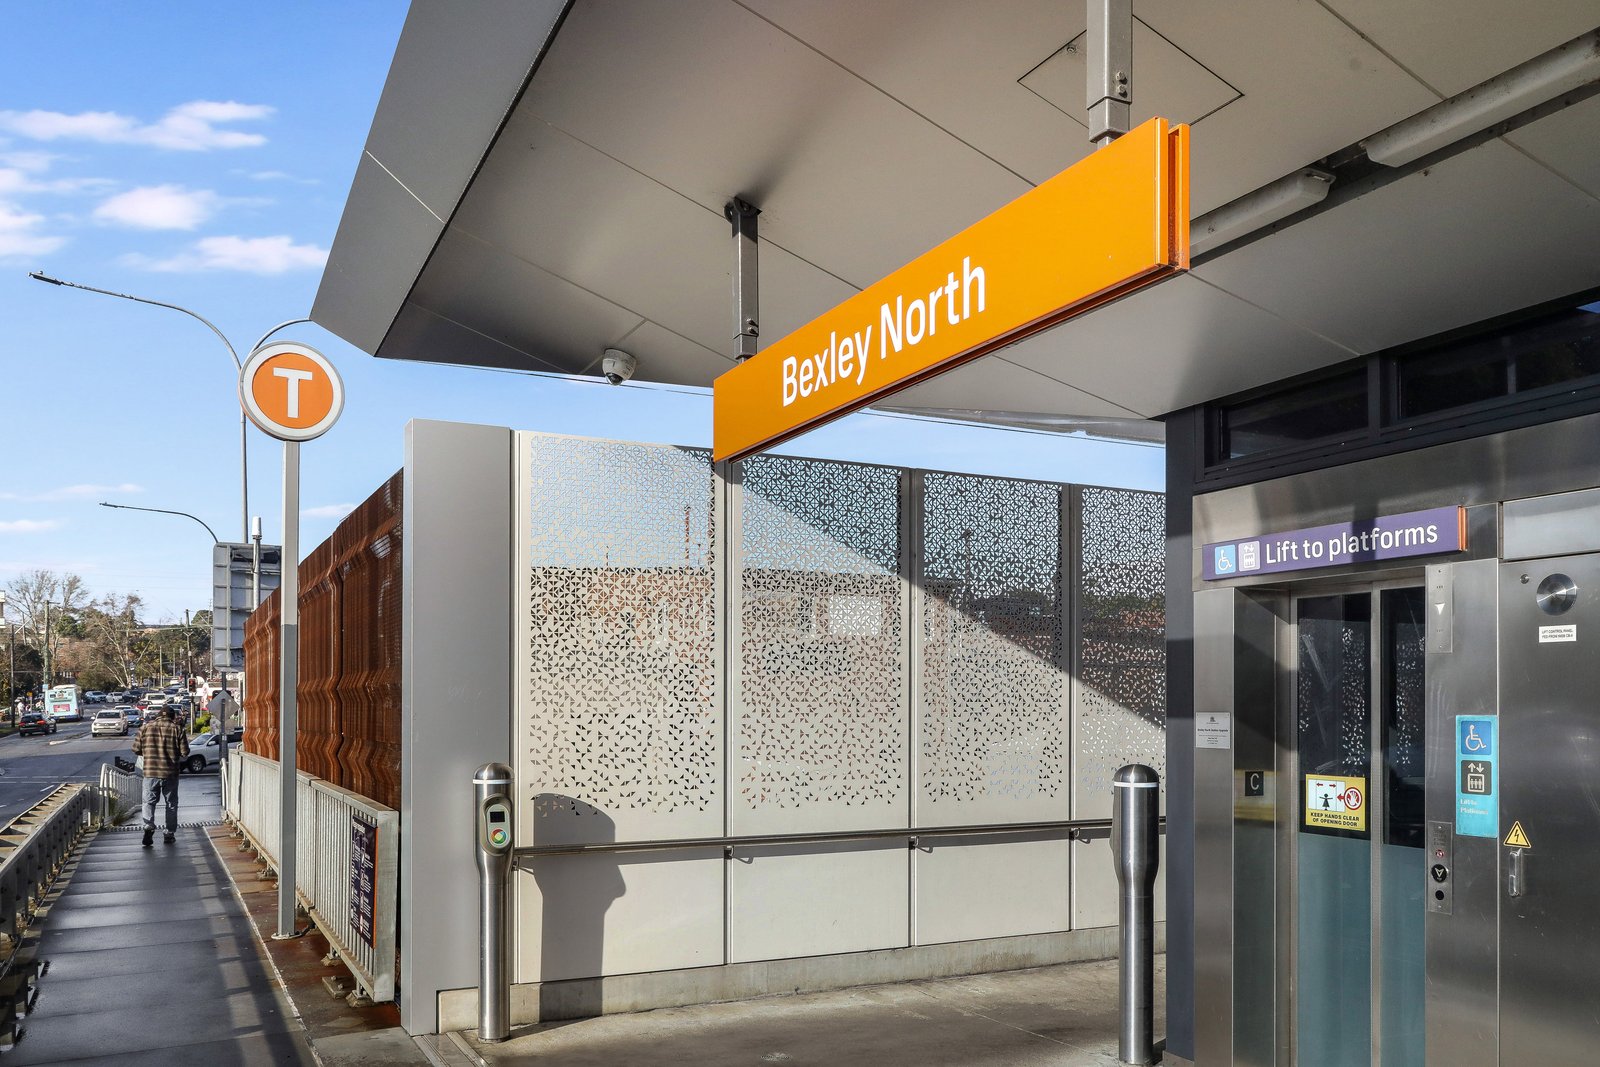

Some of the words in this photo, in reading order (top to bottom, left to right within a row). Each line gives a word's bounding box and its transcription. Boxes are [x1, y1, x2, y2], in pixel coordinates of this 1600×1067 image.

[782, 325, 872, 407] Bexley
[880, 256, 986, 360] North
[273, 367, 312, 418] T
[1266, 541, 1298, 564] Lift
[1303, 540, 1324, 559] to
[1329, 524, 1438, 561] platforms
[1250, 773, 1260, 790] C
[1320, 818, 1342, 826] OPENING
